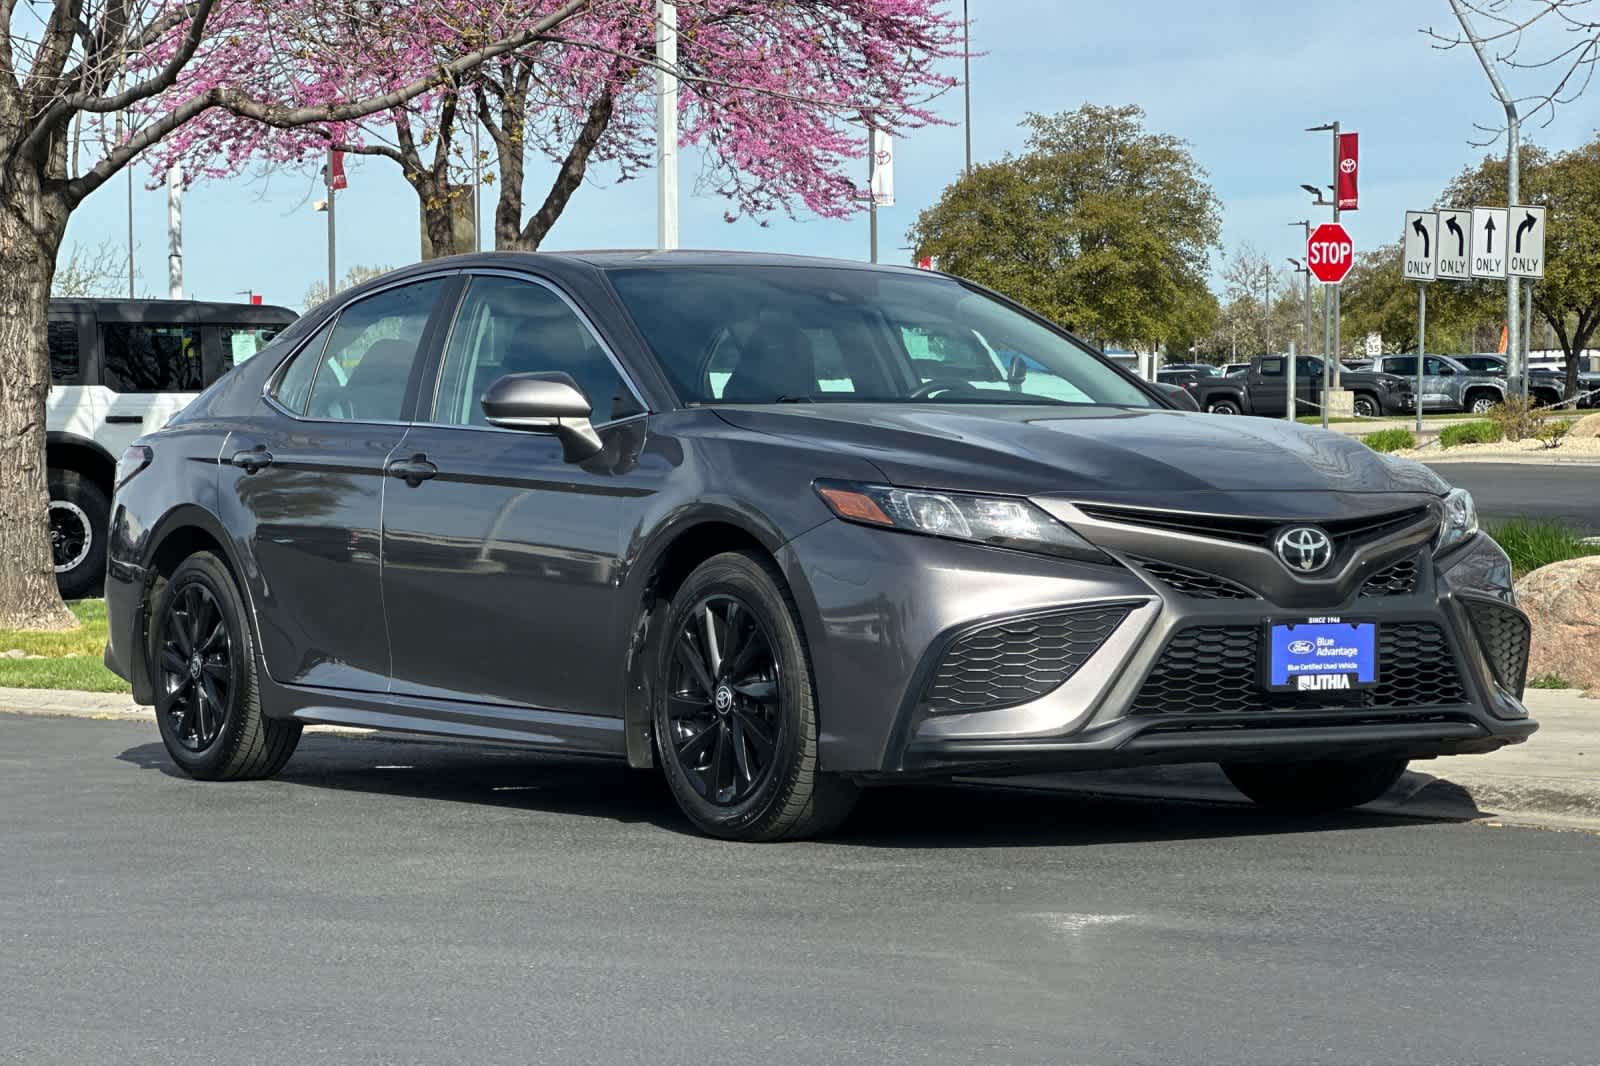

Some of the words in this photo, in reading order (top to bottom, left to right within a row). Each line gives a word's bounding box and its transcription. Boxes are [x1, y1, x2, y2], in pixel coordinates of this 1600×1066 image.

[1310, 242, 1350, 264] STOP
[1407, 261, 1431, 274] ONLY
[1440, 259, 1465, 273] ONLY
[1476, 258, 1501, 272] ONLY
[1511, 257, 1538, 272] ONLY
[1317, 637, 1334, 646] Blue
[1316, 647, 1358, 657] Advantage
[1300, 663, 1322, 671] Certified
[1338, 662, 1358, 670] Vehicle
[1310, 674, 1350, 689] LITHIA
